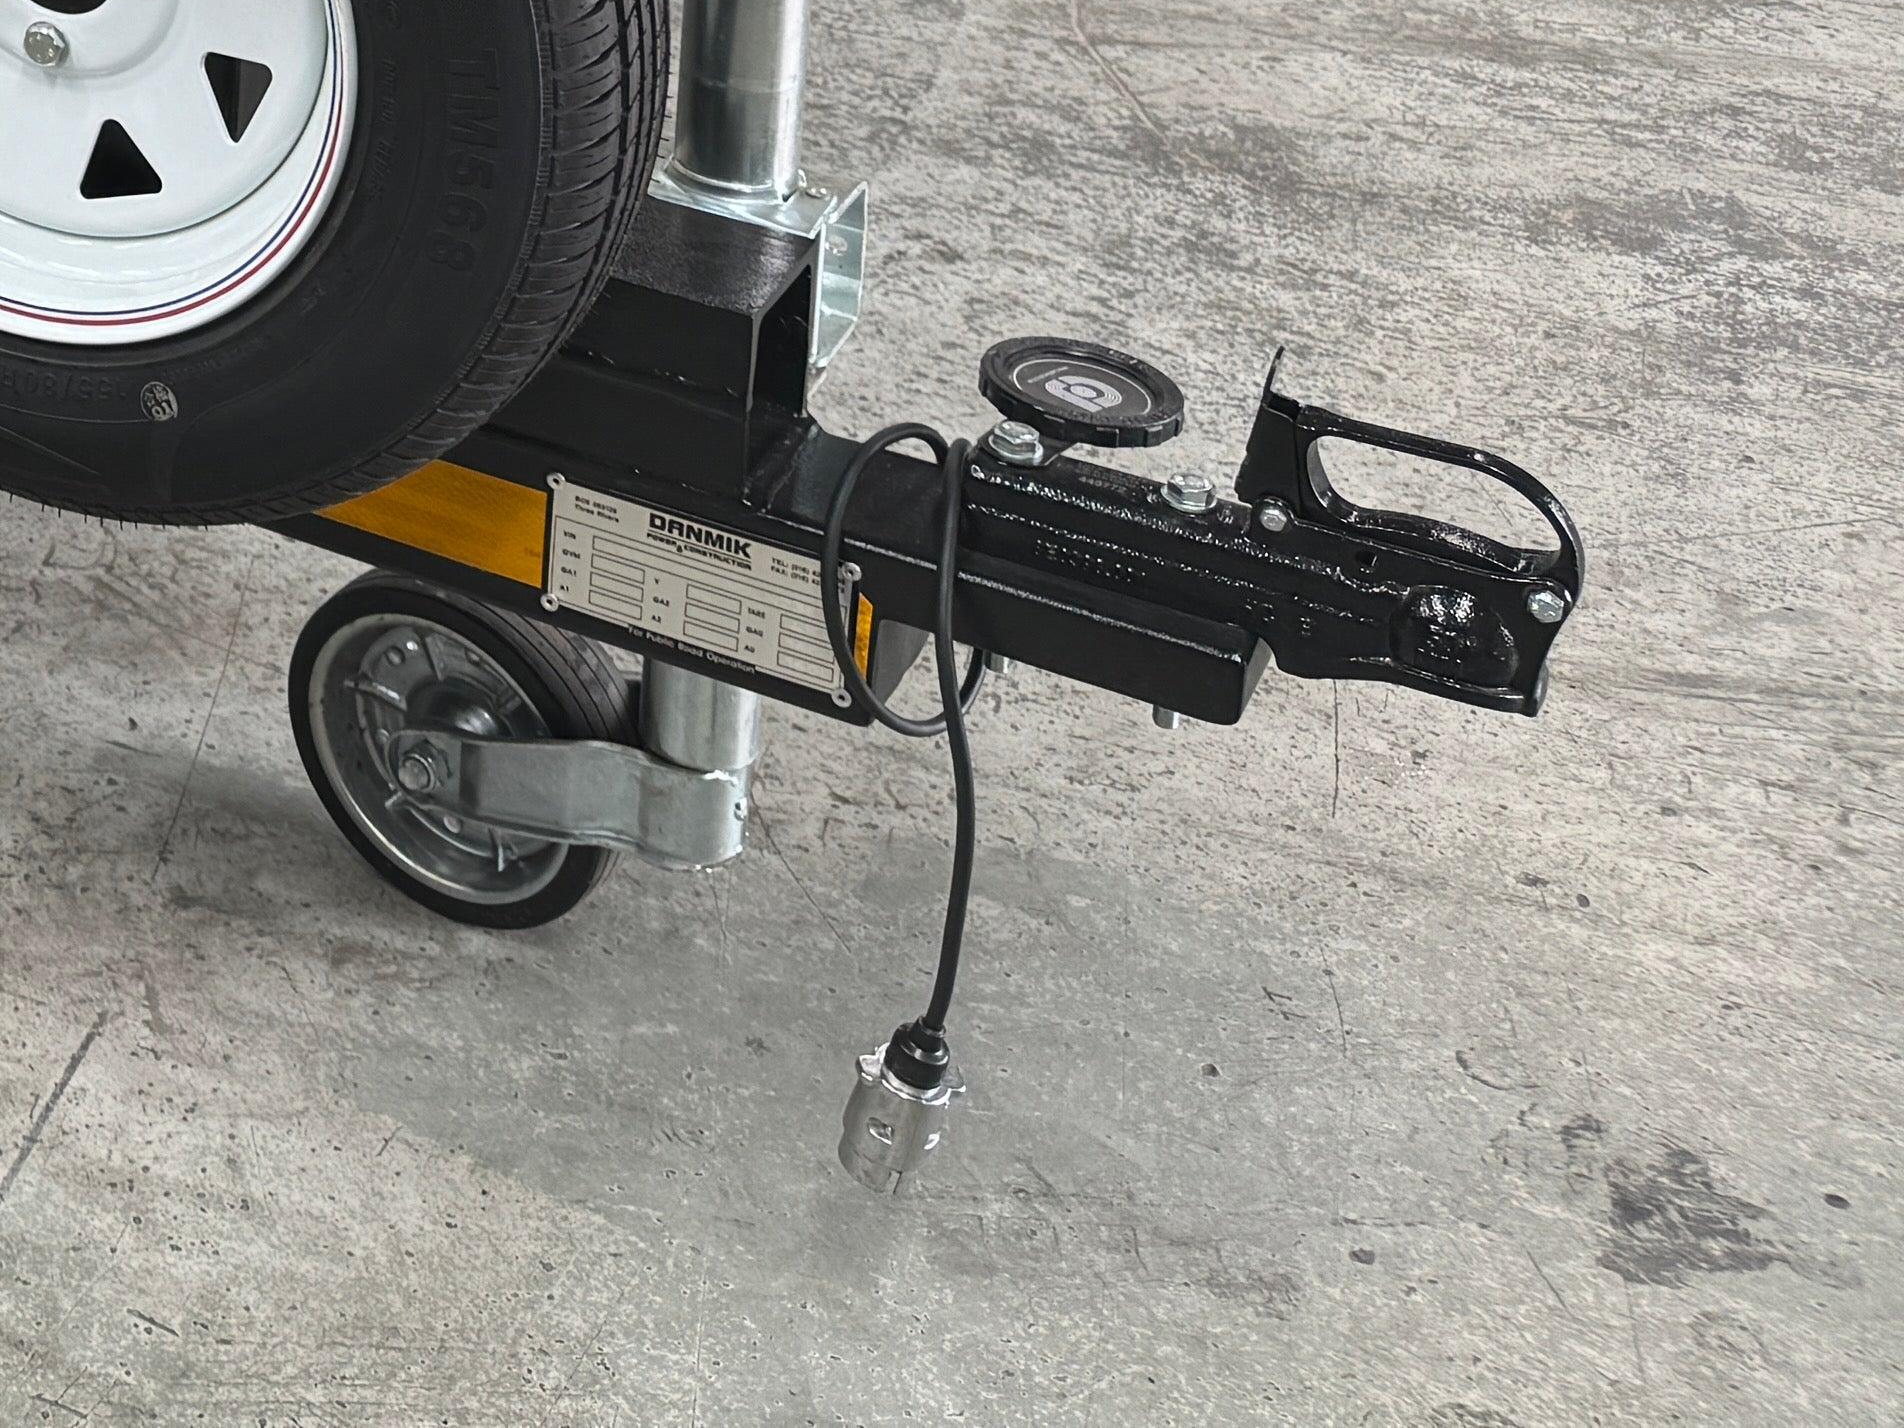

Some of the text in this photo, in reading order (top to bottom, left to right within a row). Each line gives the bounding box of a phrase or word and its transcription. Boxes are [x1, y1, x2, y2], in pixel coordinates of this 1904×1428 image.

[646, 532, 677, 547] POWER
[684, 544, 752, 571] CONSTRUCTION
[649, 512, 752, 559] DANMIK
[770, 565, 788, 577] FAX:
[772, 557, 789, 569] TEL:
[627, 626, 643, 639] For
[646, 630, 675, 648] Public
[706, 650, 756, 675] Operation
